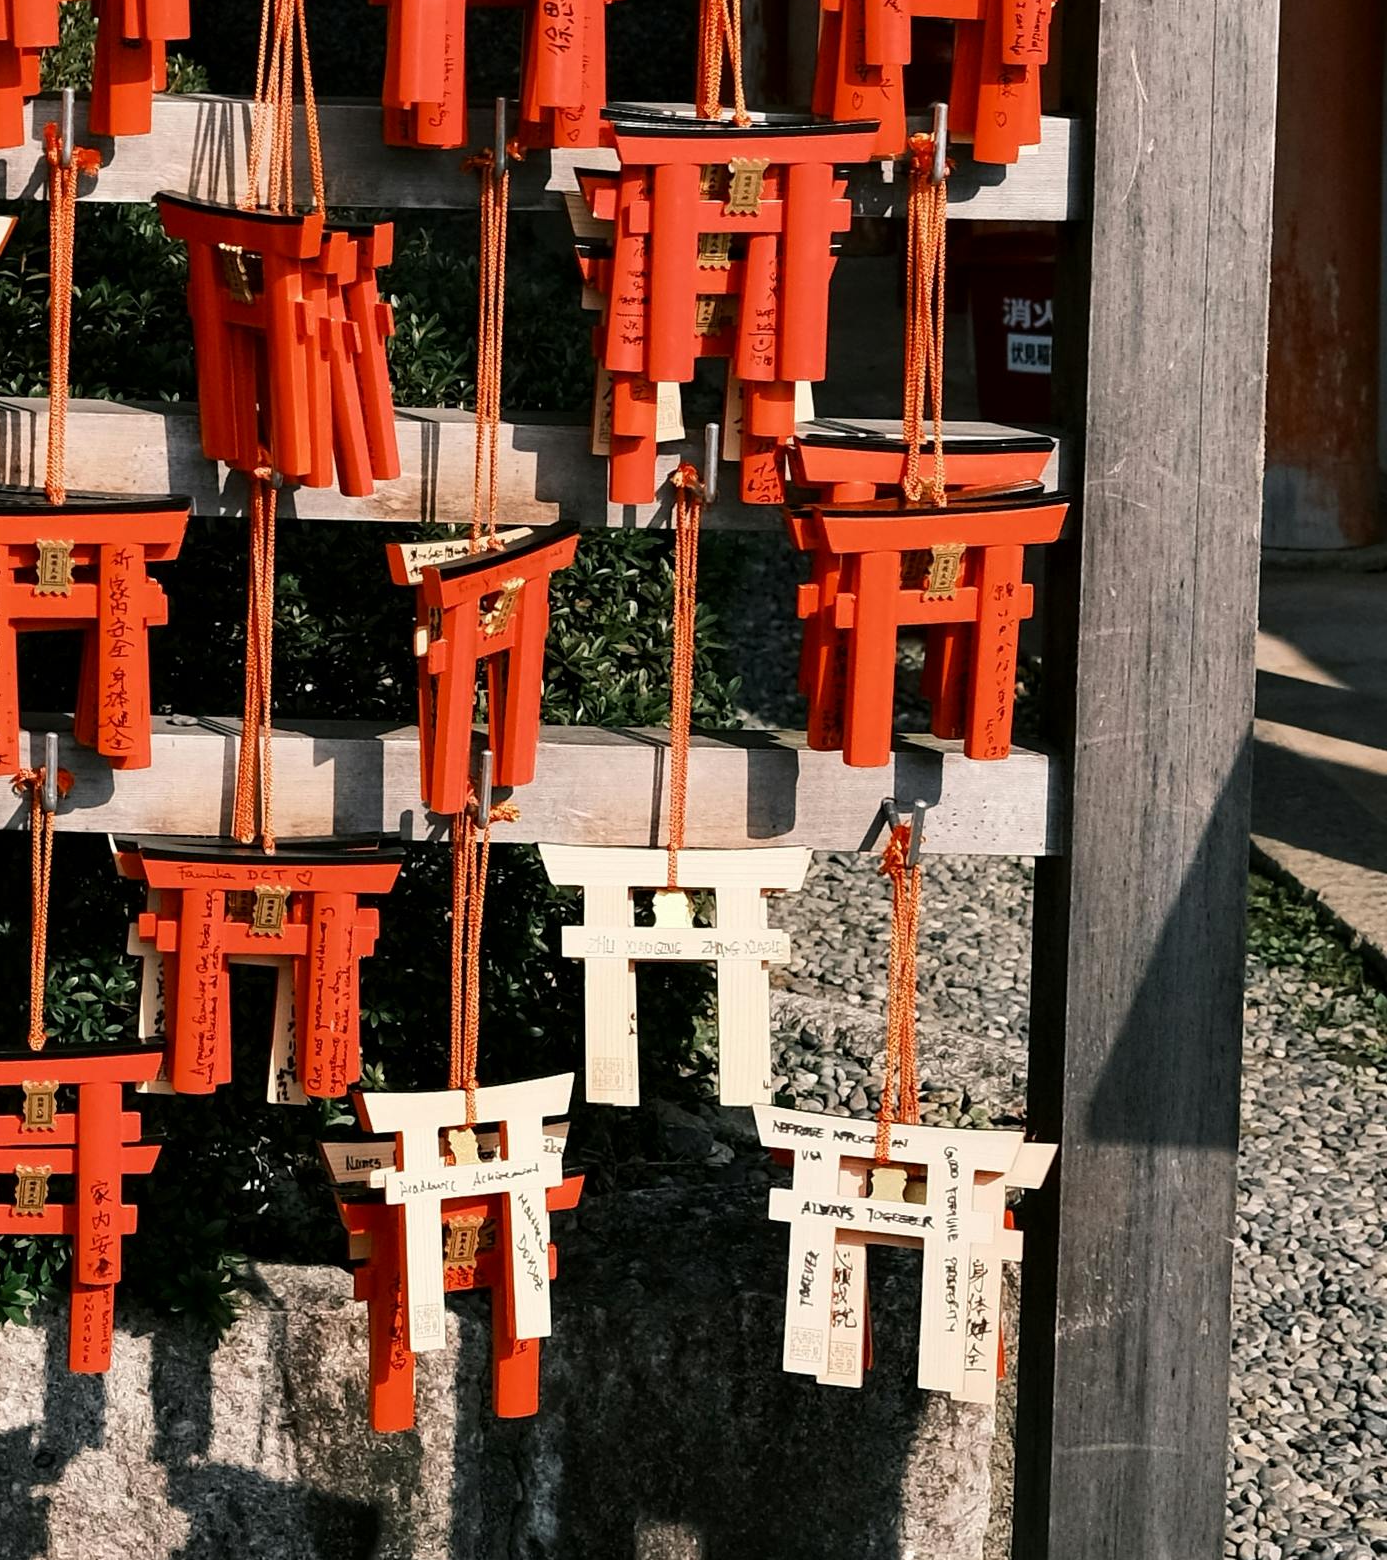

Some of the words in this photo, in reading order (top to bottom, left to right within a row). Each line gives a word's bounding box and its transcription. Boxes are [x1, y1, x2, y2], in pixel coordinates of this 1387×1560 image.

[1003, 297, 1054, 328] 消火
[246, 869, 291, 882] DCT
[345, 1154, 382, 1172] Names
[800, 1200, 856, 1221] ALWAYS
